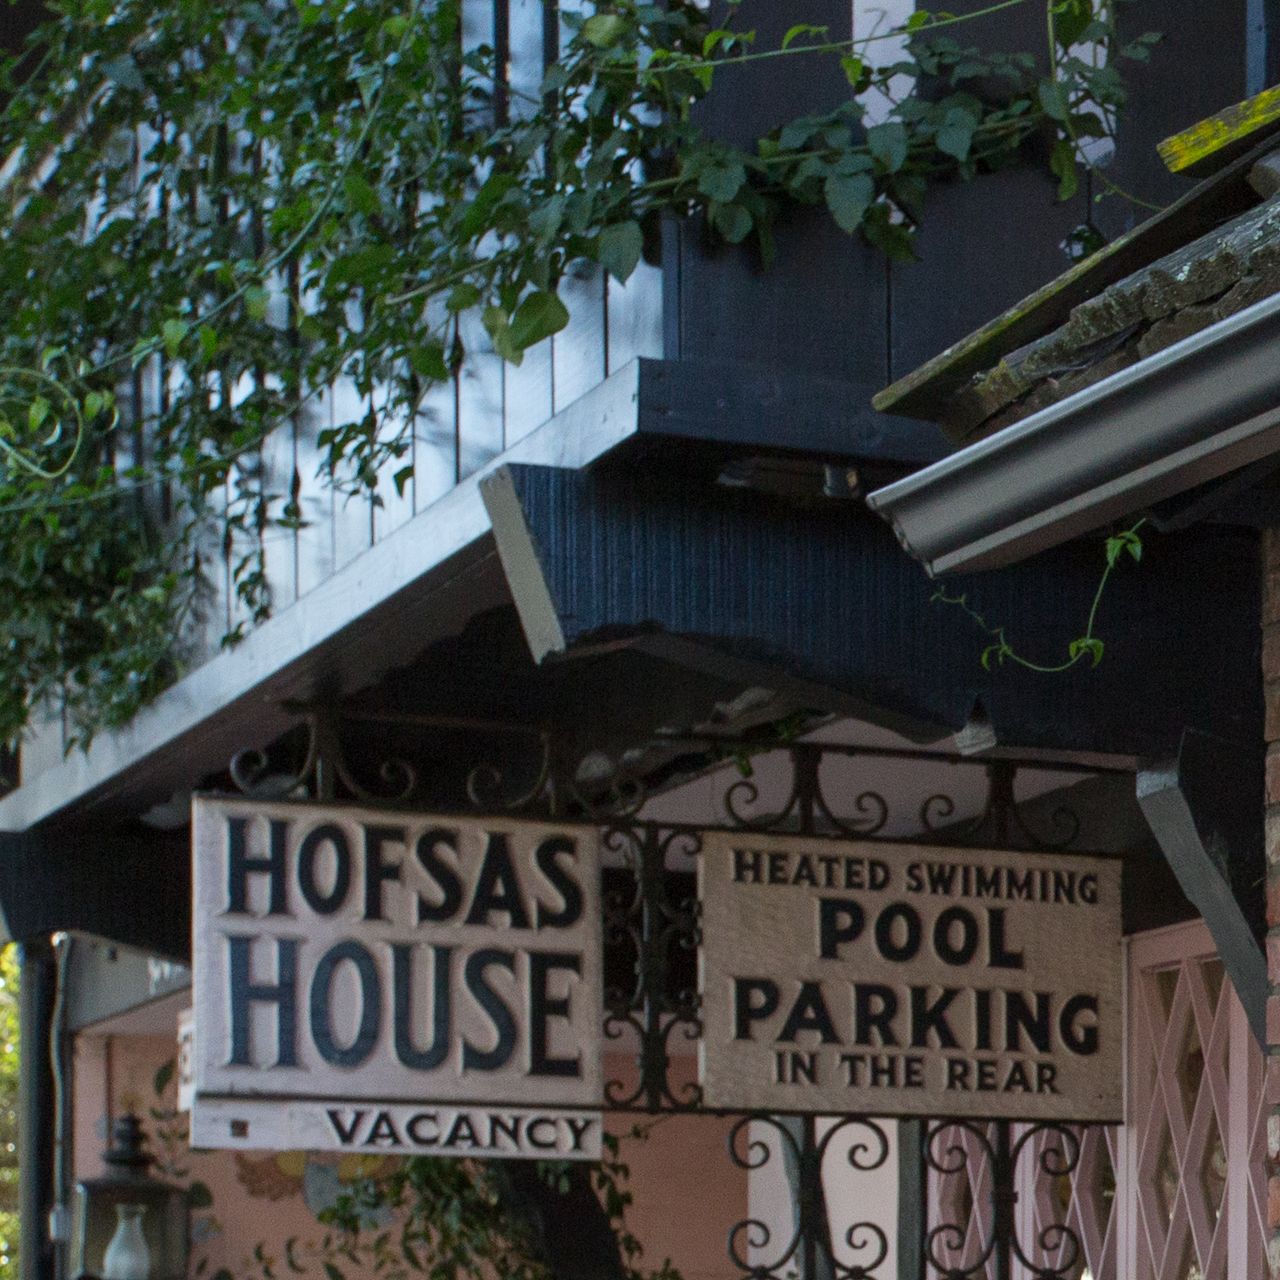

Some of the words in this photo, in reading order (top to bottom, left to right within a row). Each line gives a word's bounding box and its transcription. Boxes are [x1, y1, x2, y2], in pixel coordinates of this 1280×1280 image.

[226, 817, 584, 929] HOFSAS
[731, 849, 890, 891] HEATED
[906, 863, 1099, 904] SWIMMING
[818, 898, 1024, 970] POOL
[226, 936, 584, 1076] HOUSE
[731, 977, 1099, 1055] PARKING
[774, 1052, 817, 1084] IN
[841, 1054, 924, 1087] THE
[944, 1060, 1060, 1094] REAR
[326, 1110, 592, 1150] VACANCY
